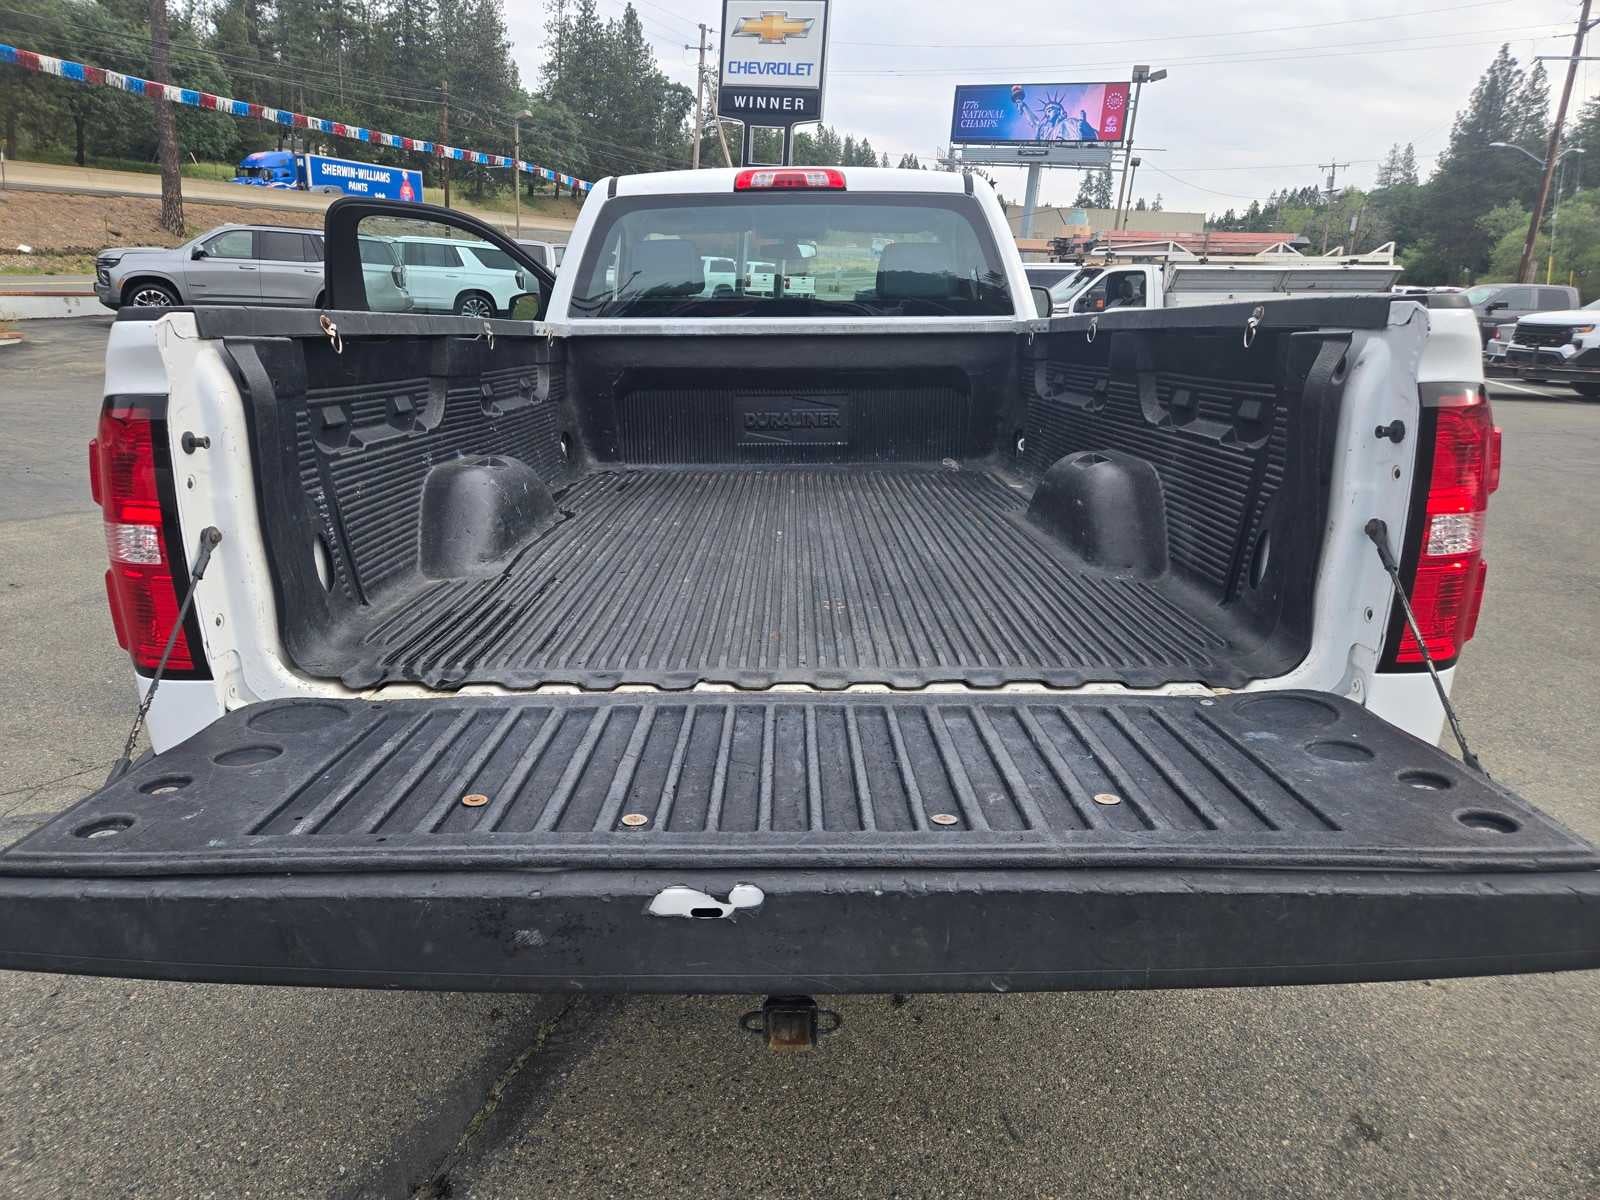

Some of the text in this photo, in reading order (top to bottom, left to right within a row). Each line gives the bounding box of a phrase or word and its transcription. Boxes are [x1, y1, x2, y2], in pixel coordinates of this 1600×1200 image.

[727, 61, 814, 76] CHEVROLET
[734, 95, 804, 110] WINNER
[962, 100, 979, 110] 1776
[961, 110, 1005, 119] NATIONAL
[321, 163, 391, 184] SHERWIN-WILLIAMS
[348, 181, 369, 193] PAINTS
